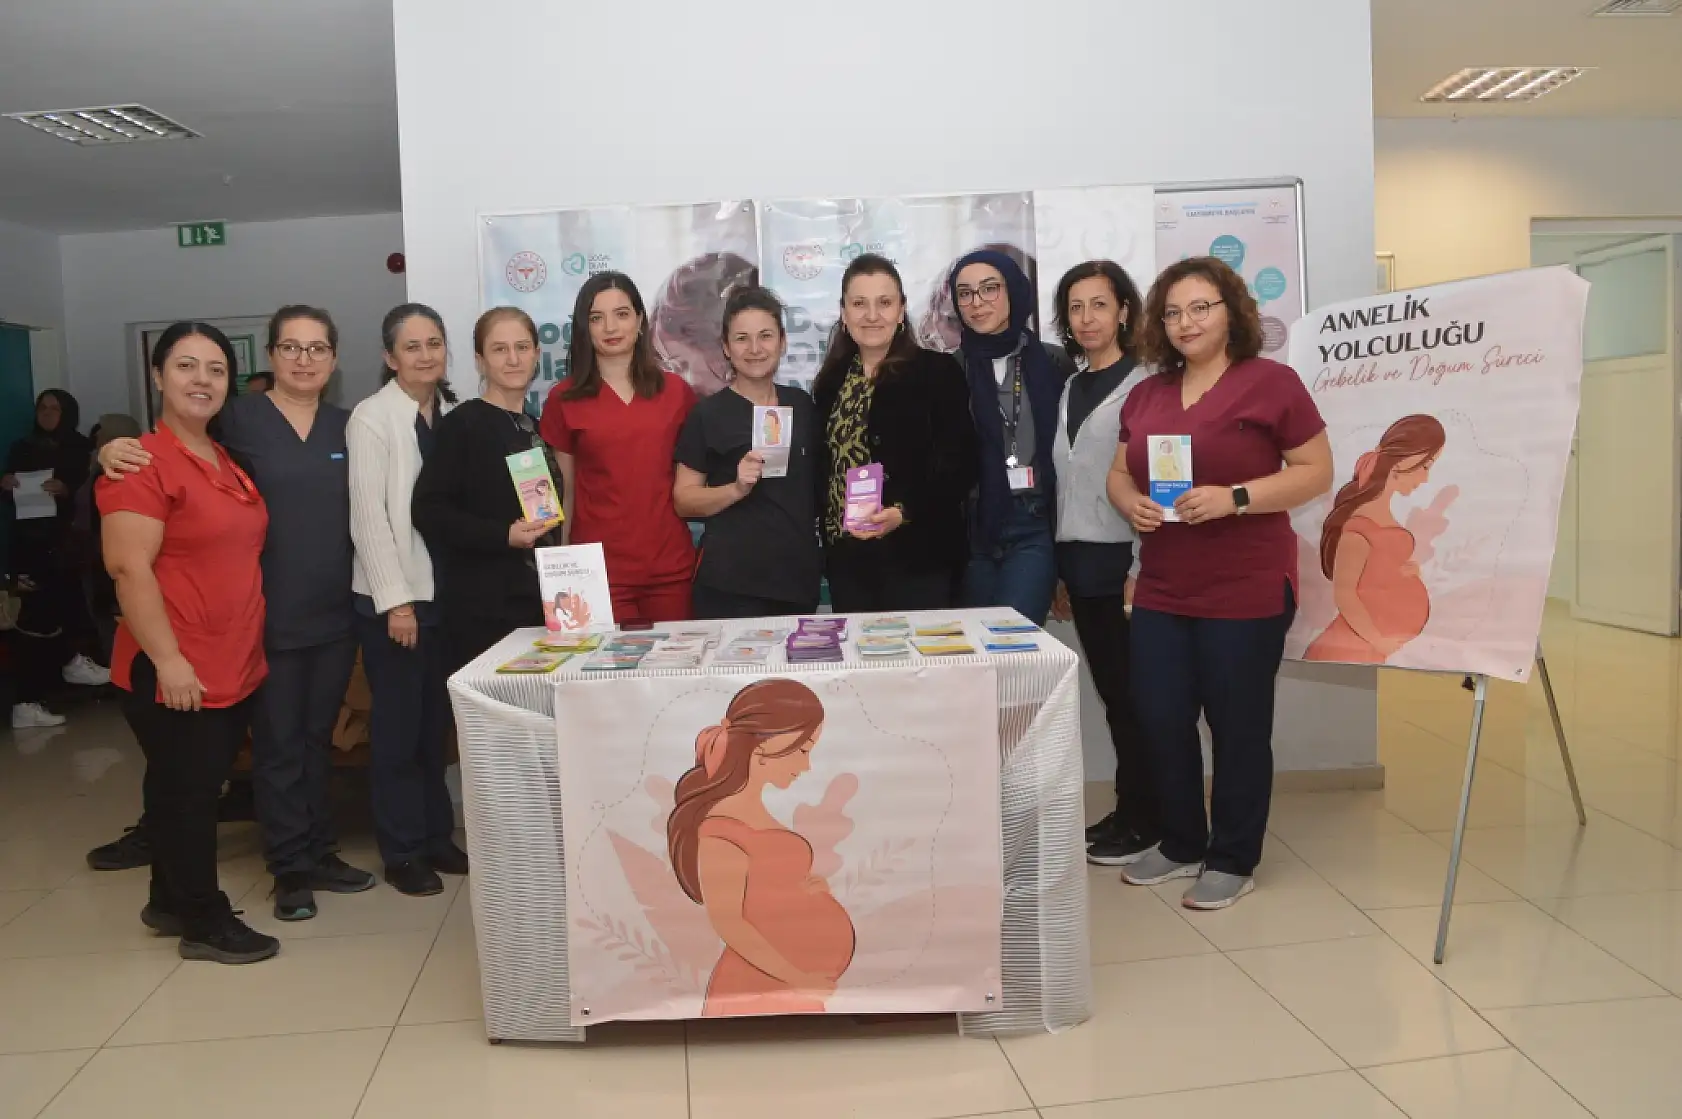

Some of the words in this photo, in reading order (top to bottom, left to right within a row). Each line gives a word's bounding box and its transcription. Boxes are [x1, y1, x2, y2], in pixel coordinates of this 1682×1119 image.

[1320, 294, 1430, 334] ANNELİK
[1318, 320, 1484, 362] YOLCULUĞU
[1312, 362, 1378, 393] Gebelik
[1383, 369, 1402, 380] ve
[1409, 353, 1475, 386] Doğum
[1481, 345, 1546, 375] Süreci
